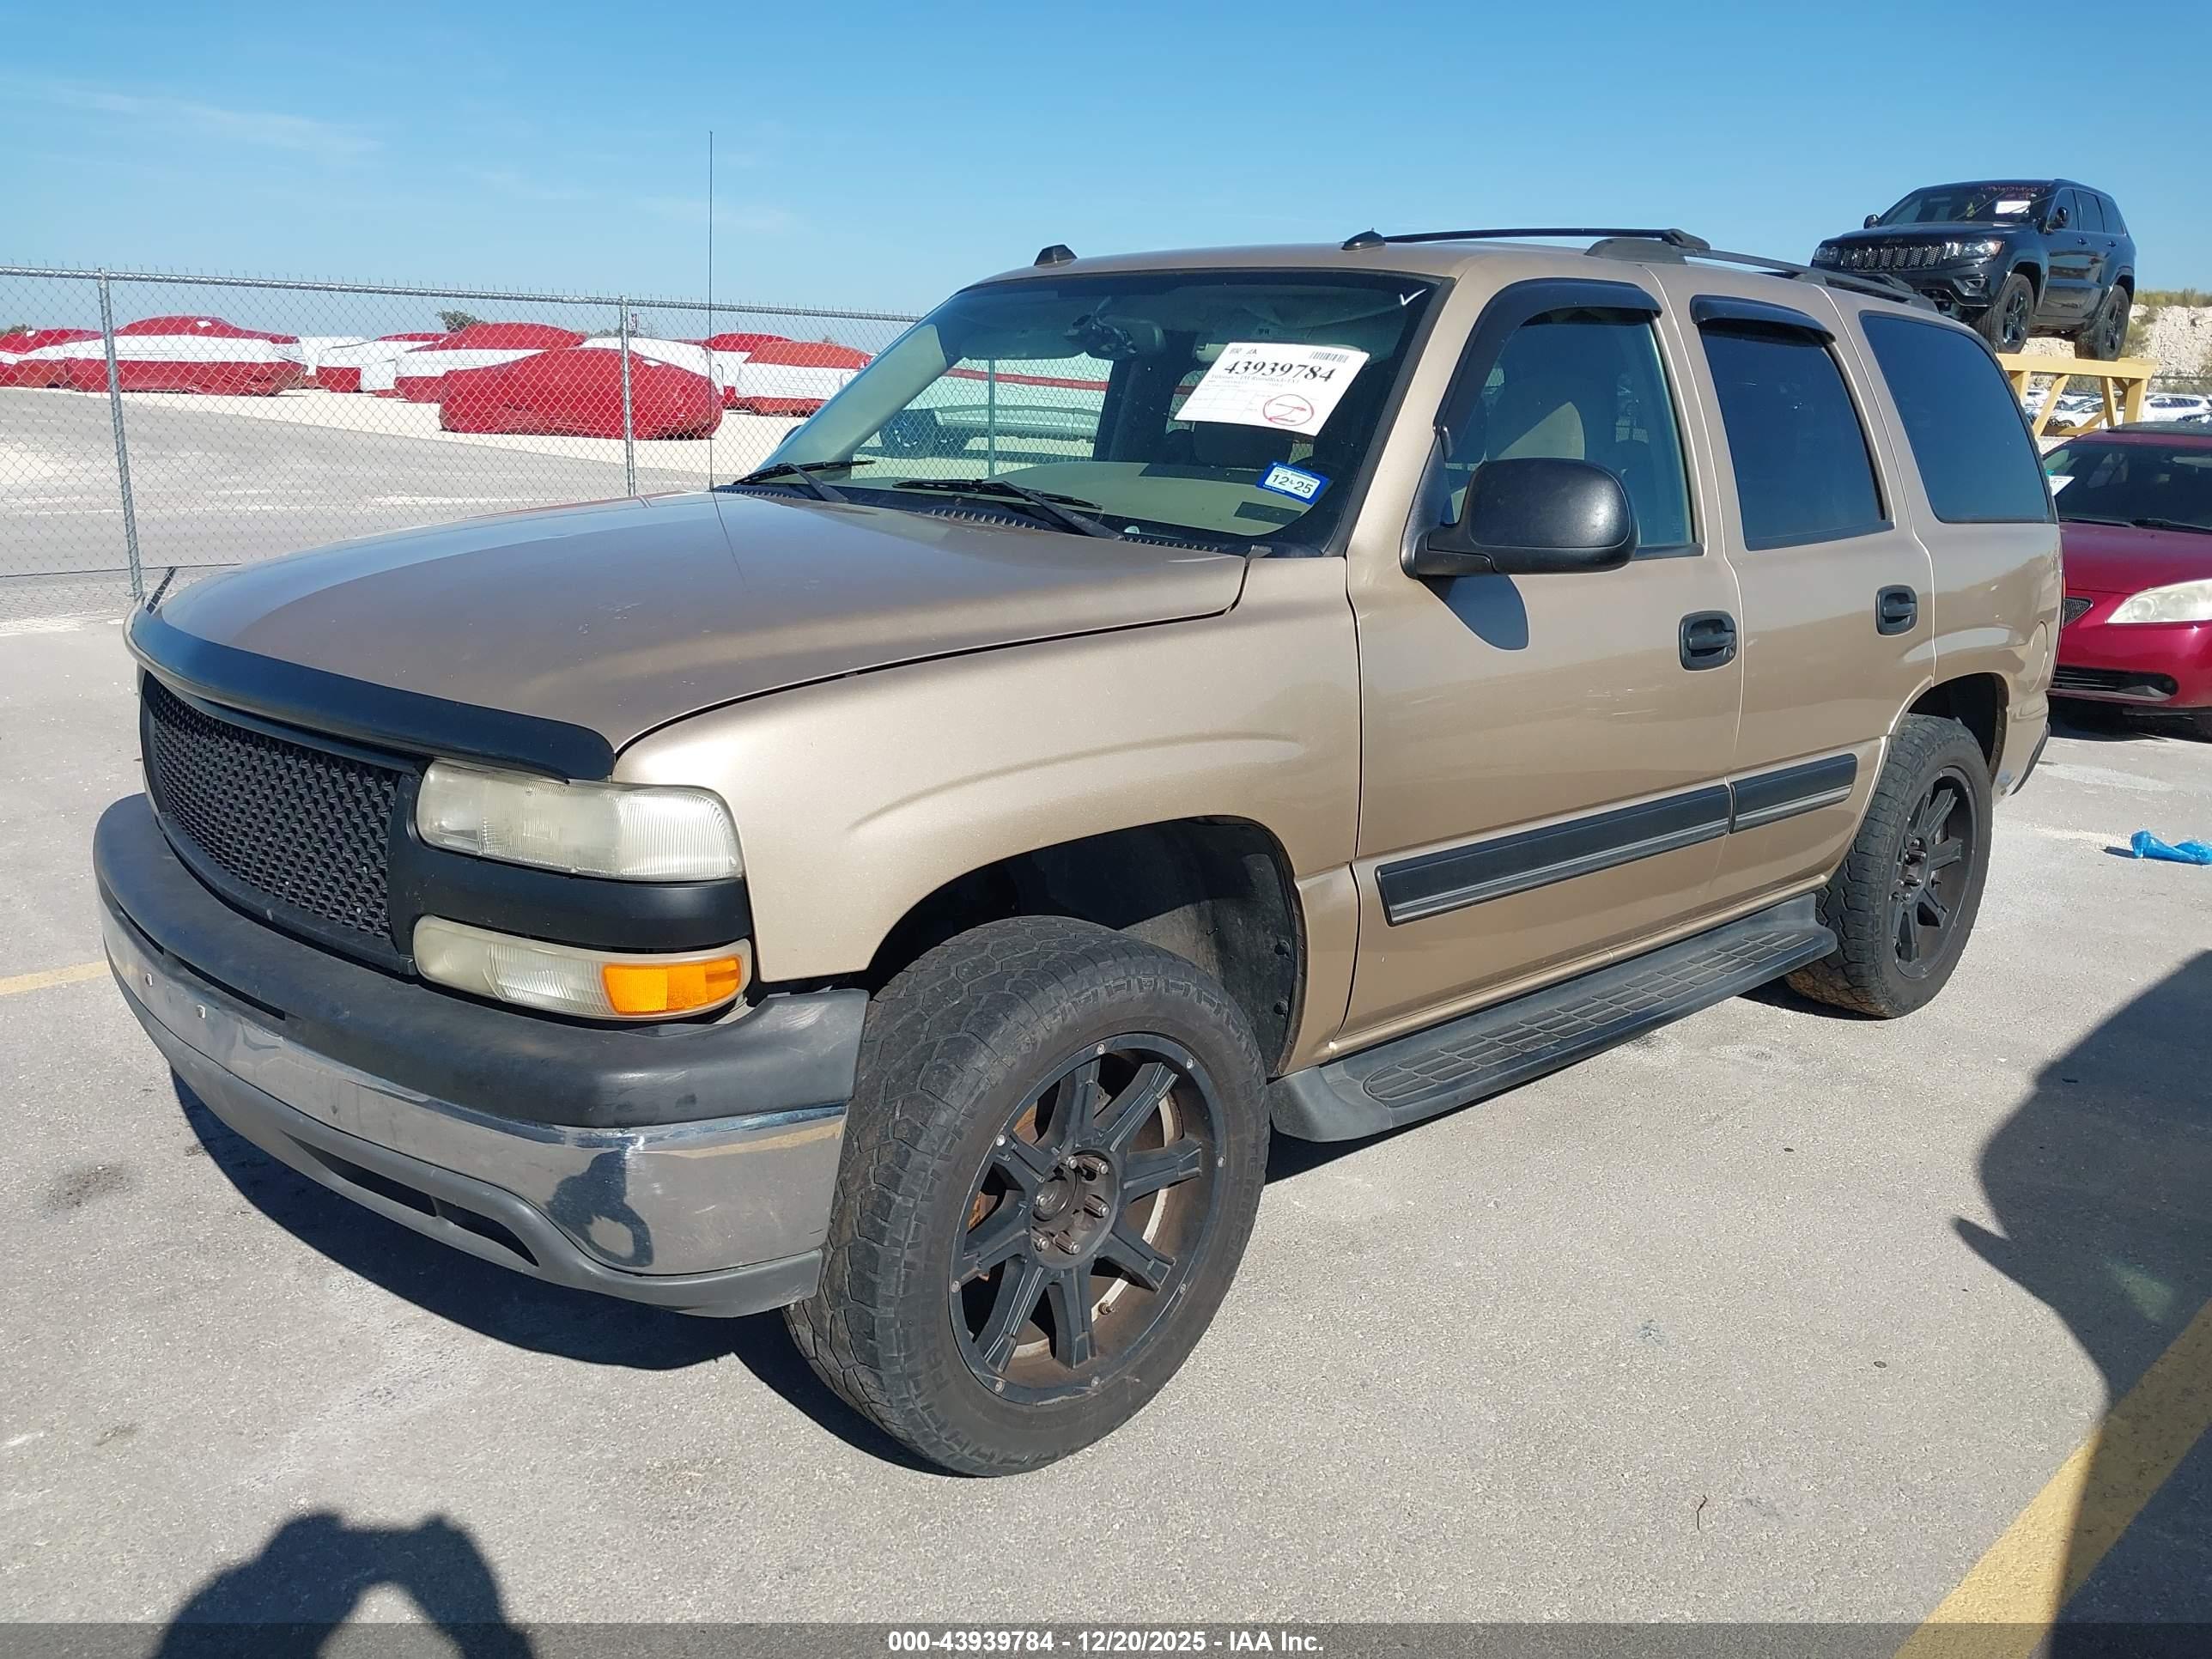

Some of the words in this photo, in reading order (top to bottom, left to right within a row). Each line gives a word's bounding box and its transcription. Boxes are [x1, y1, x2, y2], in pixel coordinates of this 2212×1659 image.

[1224, 361, 1336, 382] 43939784
[1273, 474, 1290, 486] 12
[1294, 481, 1314, 494] 25
